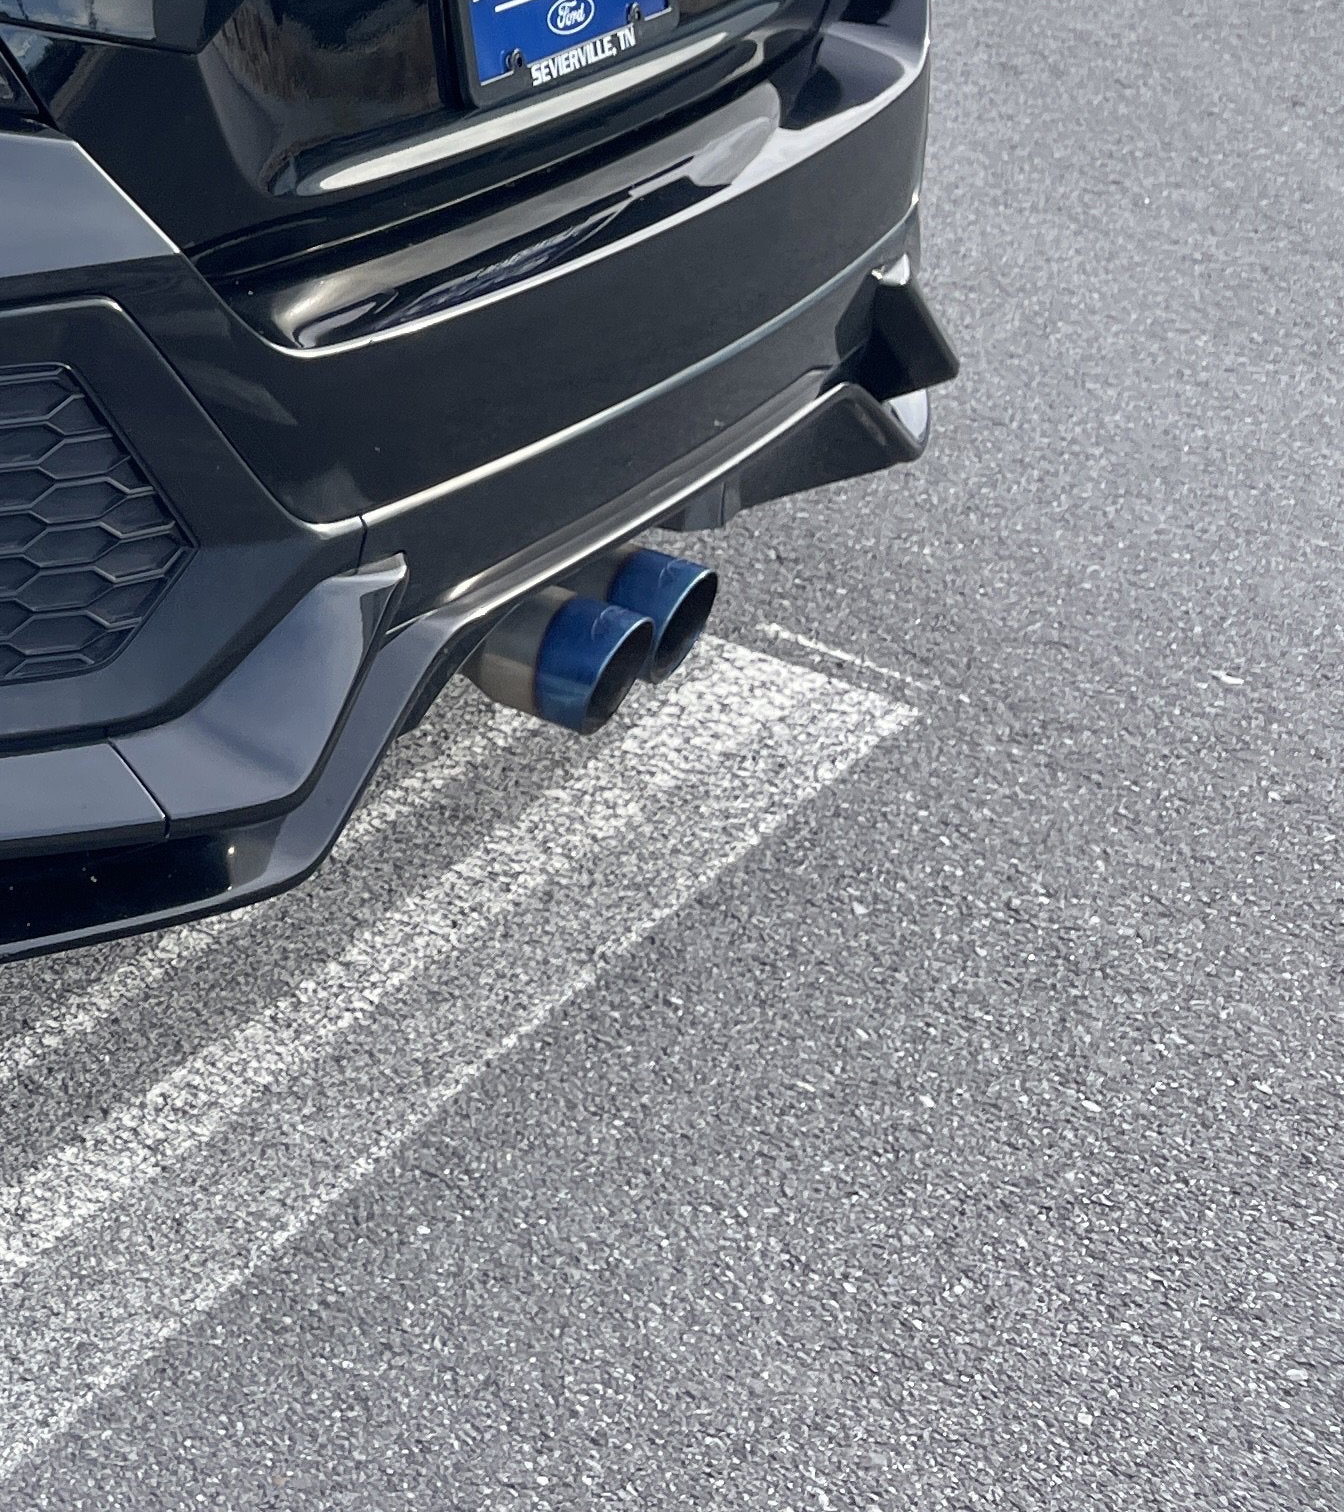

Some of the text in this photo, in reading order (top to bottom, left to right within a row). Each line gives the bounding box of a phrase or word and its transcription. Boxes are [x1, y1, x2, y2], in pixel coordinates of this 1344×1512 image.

[555, 0, 586, 29] Ford
[530, 24, 637, 87] SEVIERVILLE, TN
